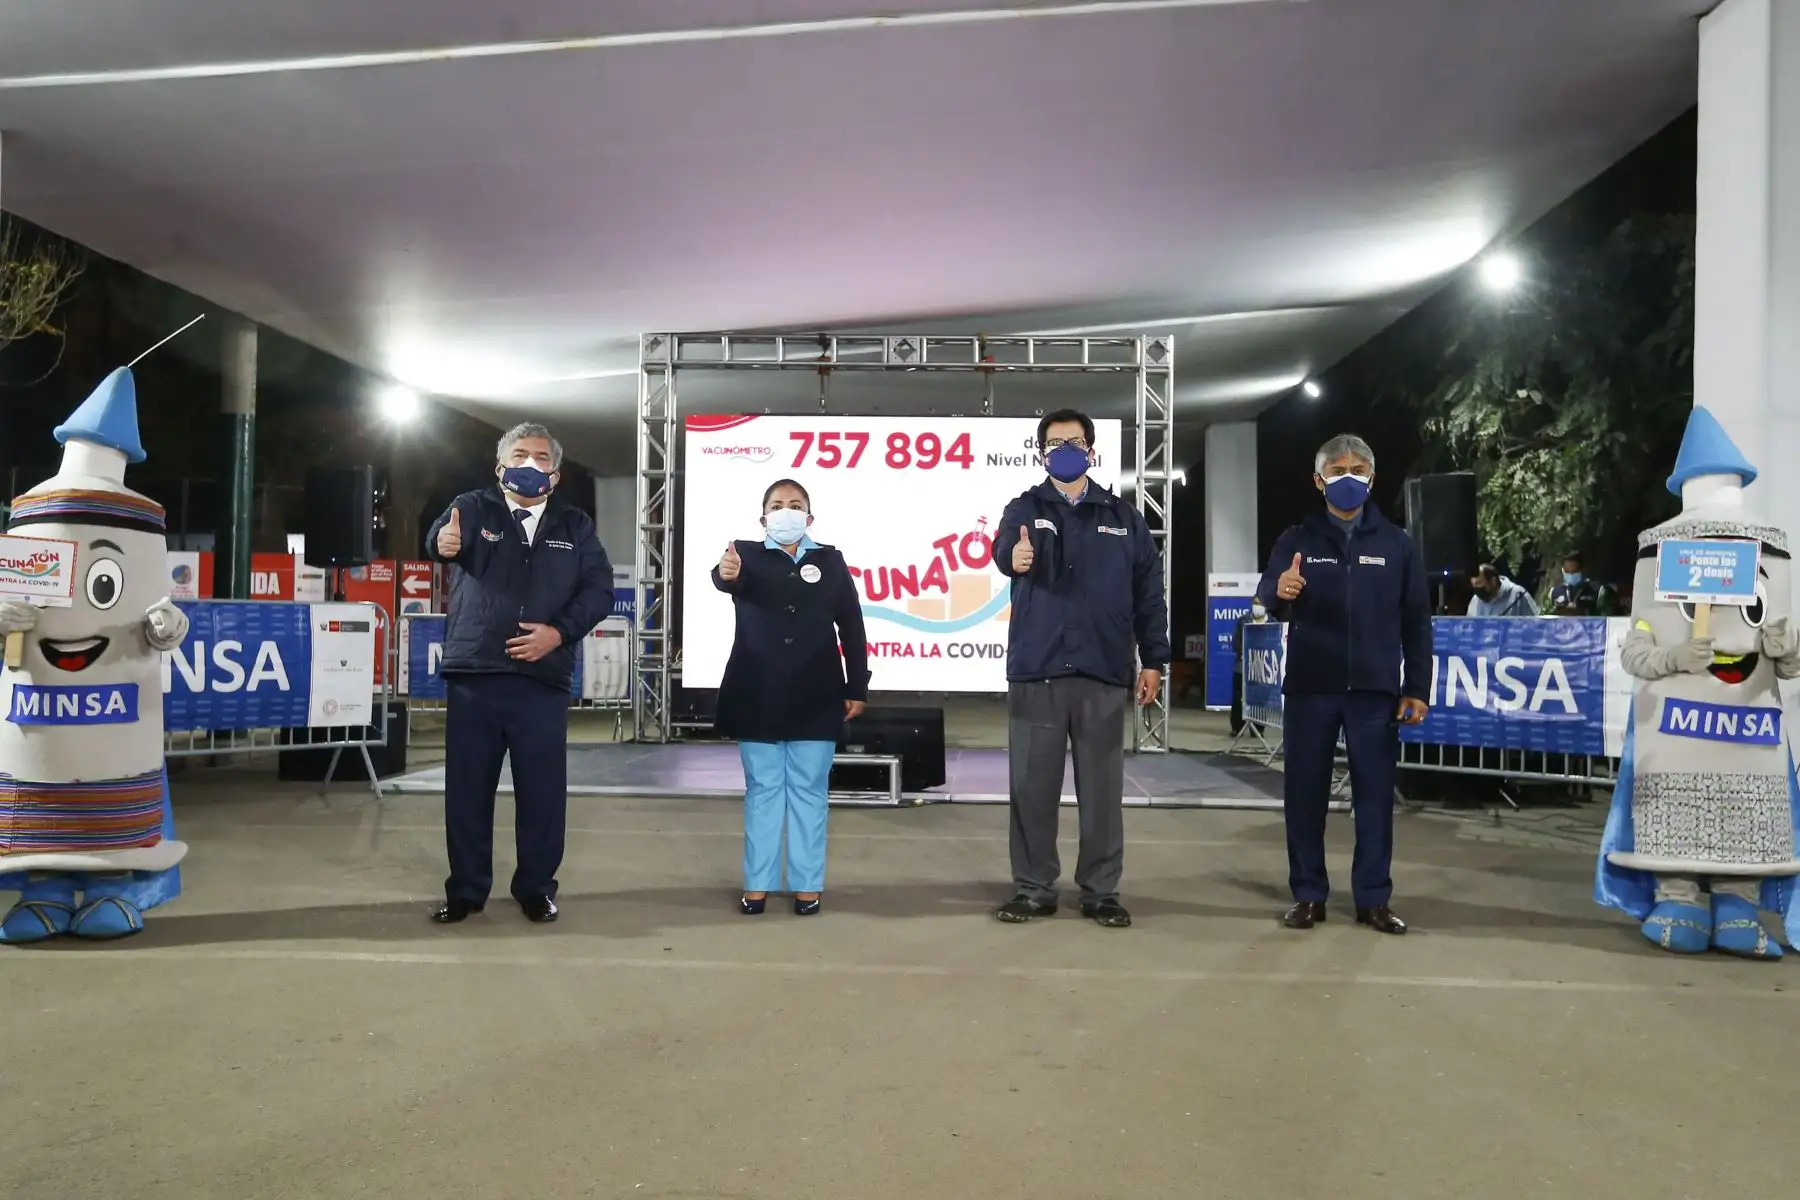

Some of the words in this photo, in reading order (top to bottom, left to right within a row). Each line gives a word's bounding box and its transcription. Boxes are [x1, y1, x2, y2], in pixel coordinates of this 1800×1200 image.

[790, 432, 870, 469] 757
[885, 432, 974, 469] 894
[987, 453, 1027, 467] Nivel
[1688, 566, 1703, 587] 2
[1703, 567, 1734, 578] dosis
[865, 642, 916, 658] NTRA
[920, 643, 942, 658] LA
[1248, 648, 1279, 685] MINSA
[1400, 655, 1578, 713] INSA
[16, 690, 127, 717] MINSA
[1670, 706, 1775, 737] MINSA
